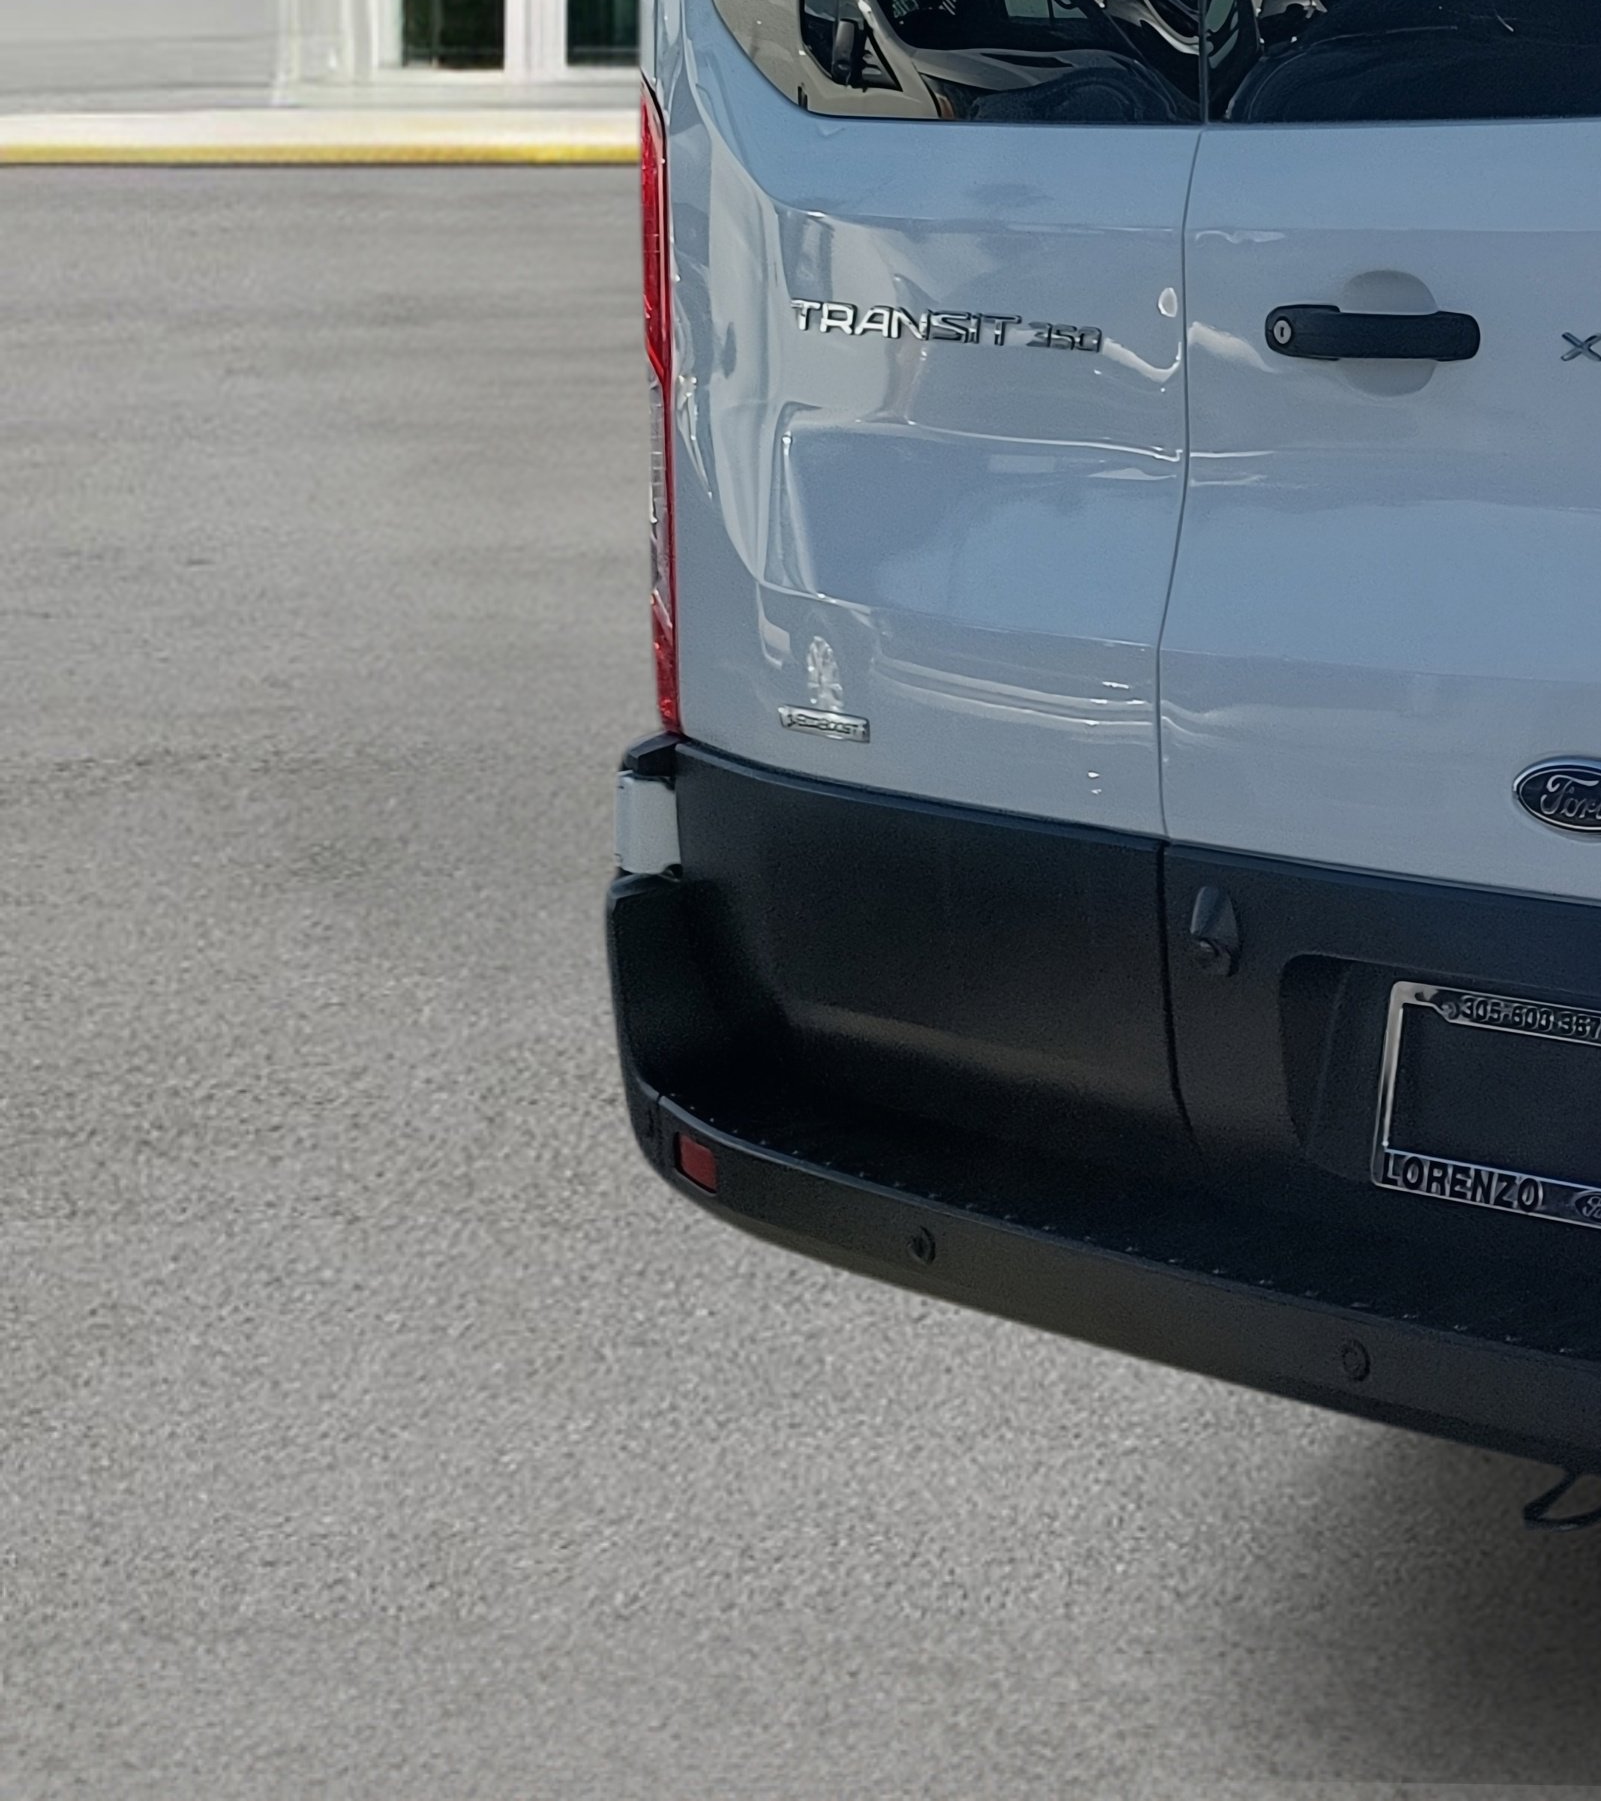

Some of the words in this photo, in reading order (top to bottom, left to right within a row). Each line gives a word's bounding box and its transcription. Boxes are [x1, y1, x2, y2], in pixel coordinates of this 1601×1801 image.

[790, 296, 1023, 347] TRANSIT
[1026, 320, 1103, 353] 350
[1380, 1151, 1544, 1212] LORENZO
